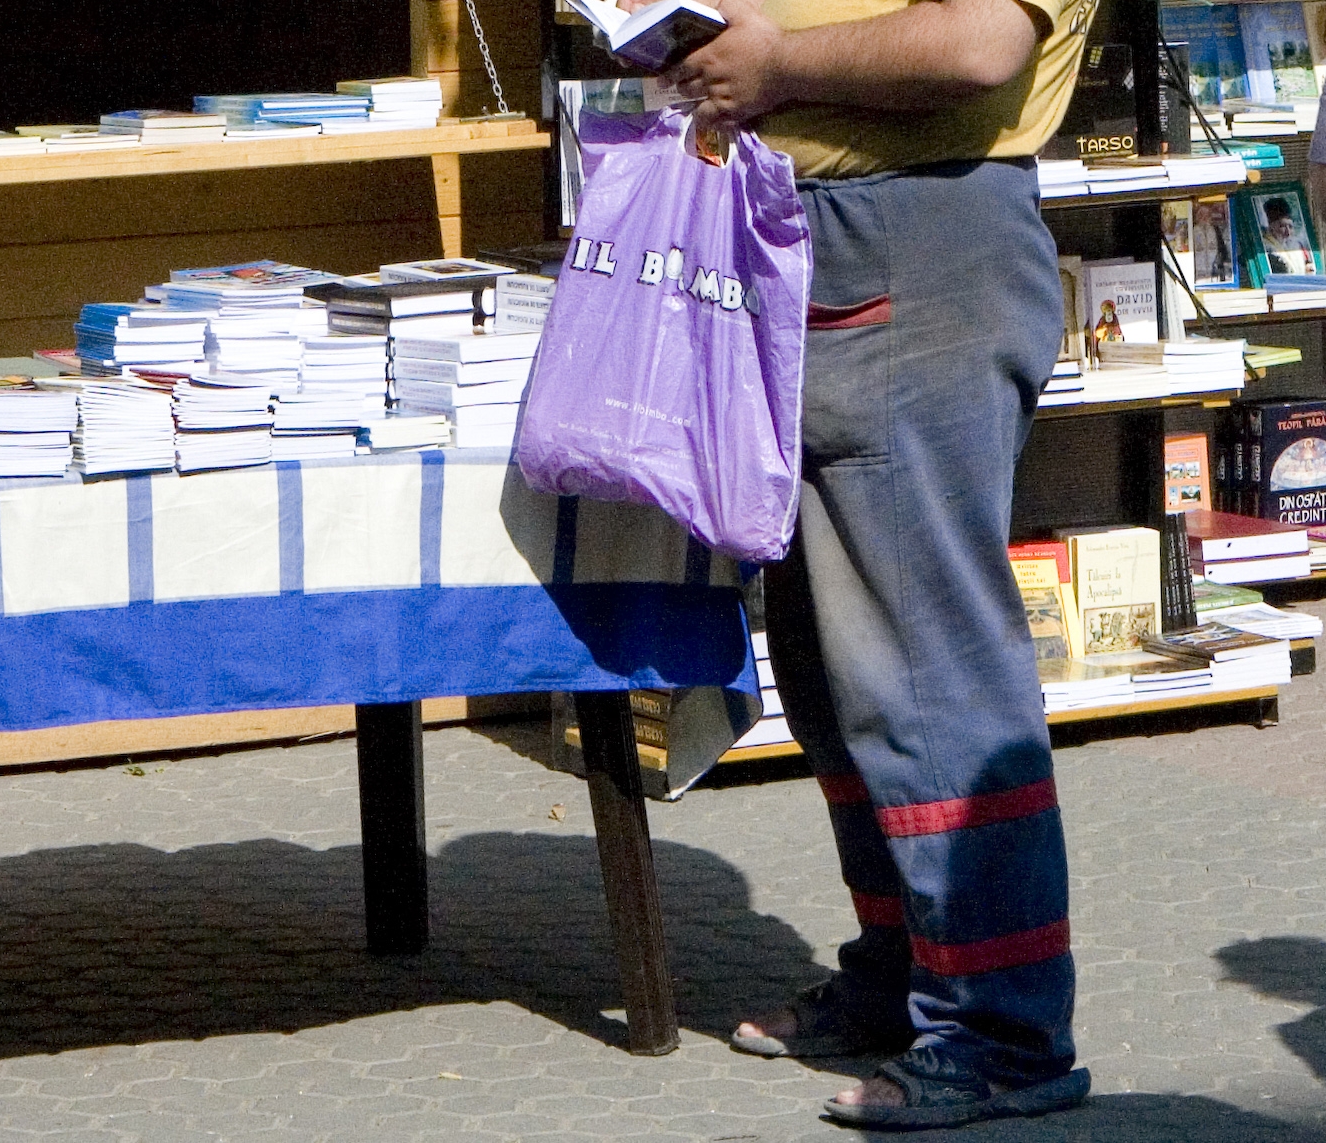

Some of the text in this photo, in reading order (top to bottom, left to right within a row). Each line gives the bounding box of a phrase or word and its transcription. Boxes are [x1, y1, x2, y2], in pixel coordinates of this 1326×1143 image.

[1076, 135, 1133, 153] TARSO
[570, 237, 617, 277] IL
[1117, 293, 1153, 306] DAVID
[1279, 496, 1296, 511] DIN
